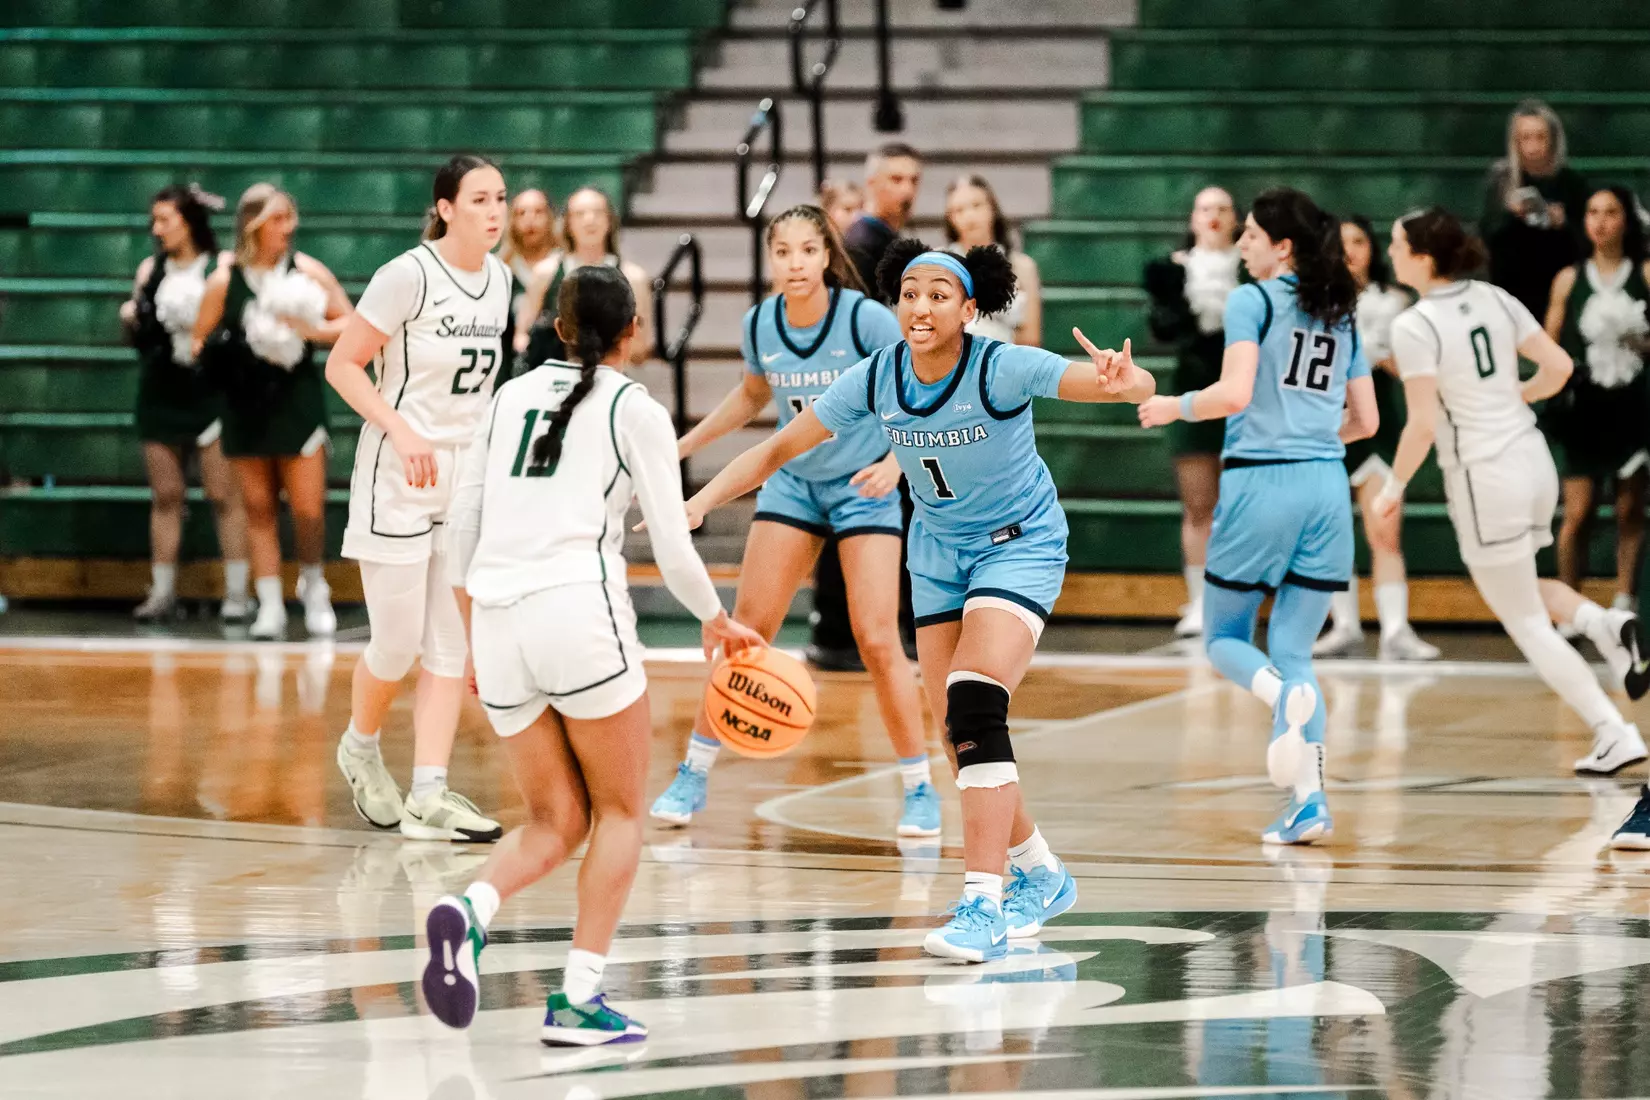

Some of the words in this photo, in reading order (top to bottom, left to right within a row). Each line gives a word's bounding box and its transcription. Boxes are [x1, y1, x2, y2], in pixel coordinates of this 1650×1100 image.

[436, 315, 503, 337] Seahawk
[451, 348, 496, 394] 23
[1282, 329, 1338, 393] 12
[1470, 326, 1496, 378] 0
[765, 367, 850, 388] OLUMBI
[920, 457, 957, 500] 1
[728, 671, 792, 718] Wilson
[721, 708, 772, 741] NCAA
